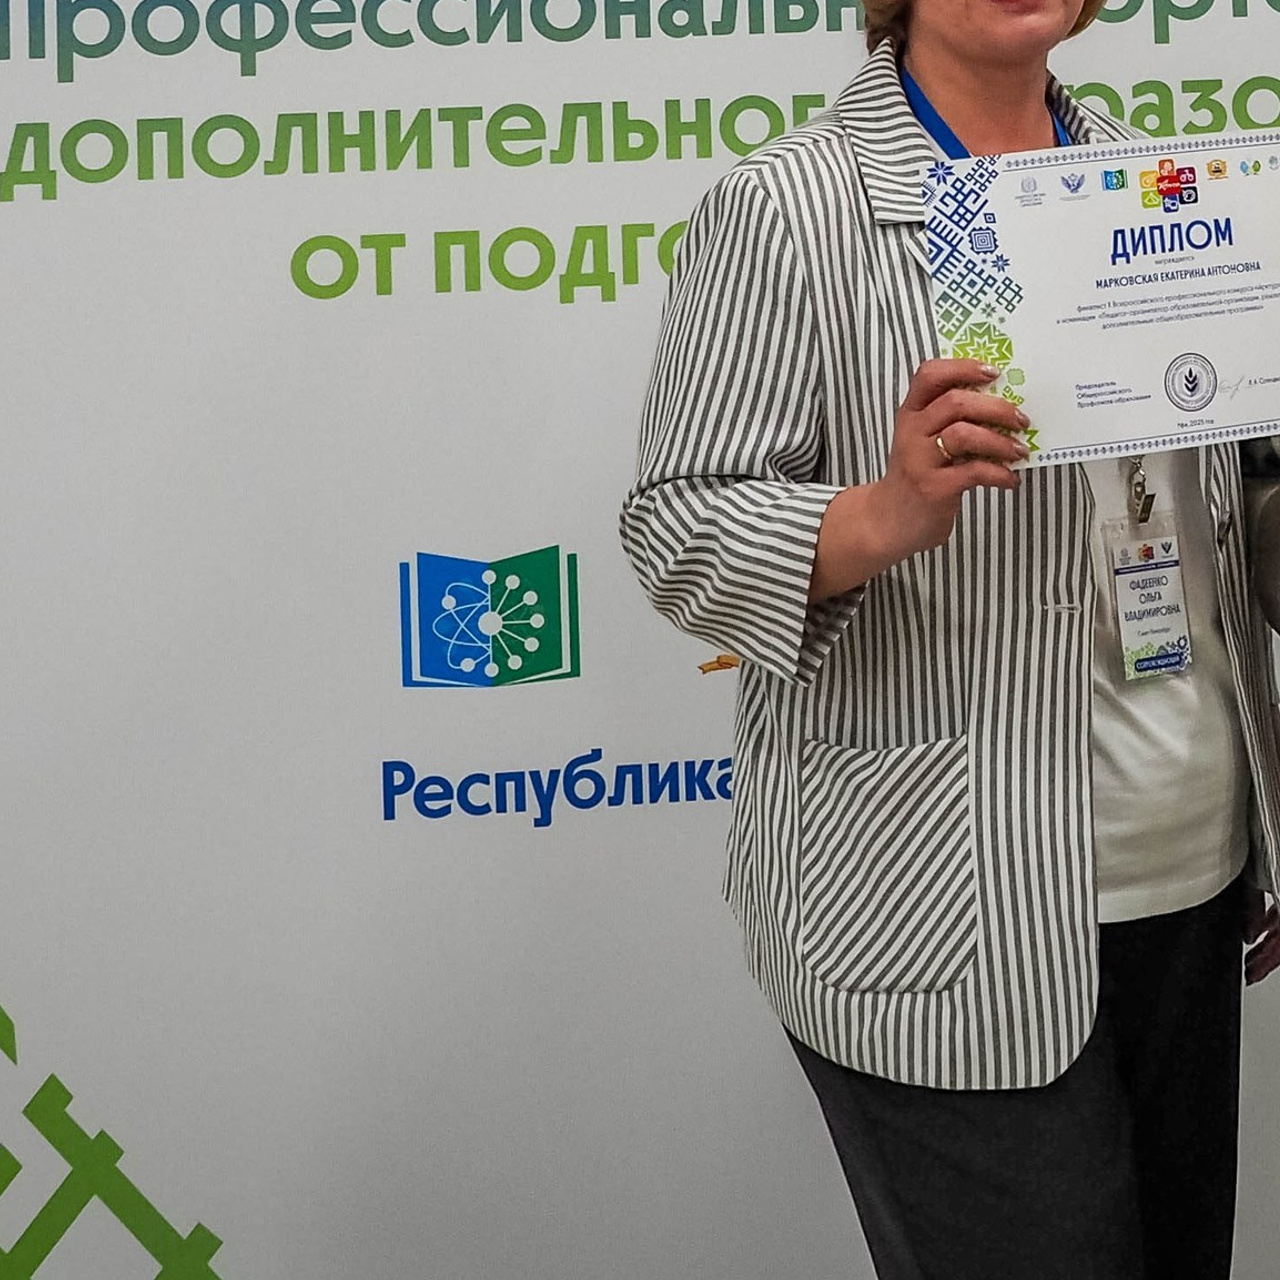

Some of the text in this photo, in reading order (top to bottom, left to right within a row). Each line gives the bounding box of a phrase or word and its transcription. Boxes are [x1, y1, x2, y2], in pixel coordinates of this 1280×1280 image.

[1111, 217, 1234, 266] ДИПЛОМ
[290, 233, 406, 300] от
[1096, 260, 1262, 290] МАРКОВСКАЯ ЕКАТЕРИНА АНТОНОВНА
[1138, 591, 1162, 604] ОЛЬГА
[1124, 604, 1181, 622] ВЛАДИМИРОВНА
